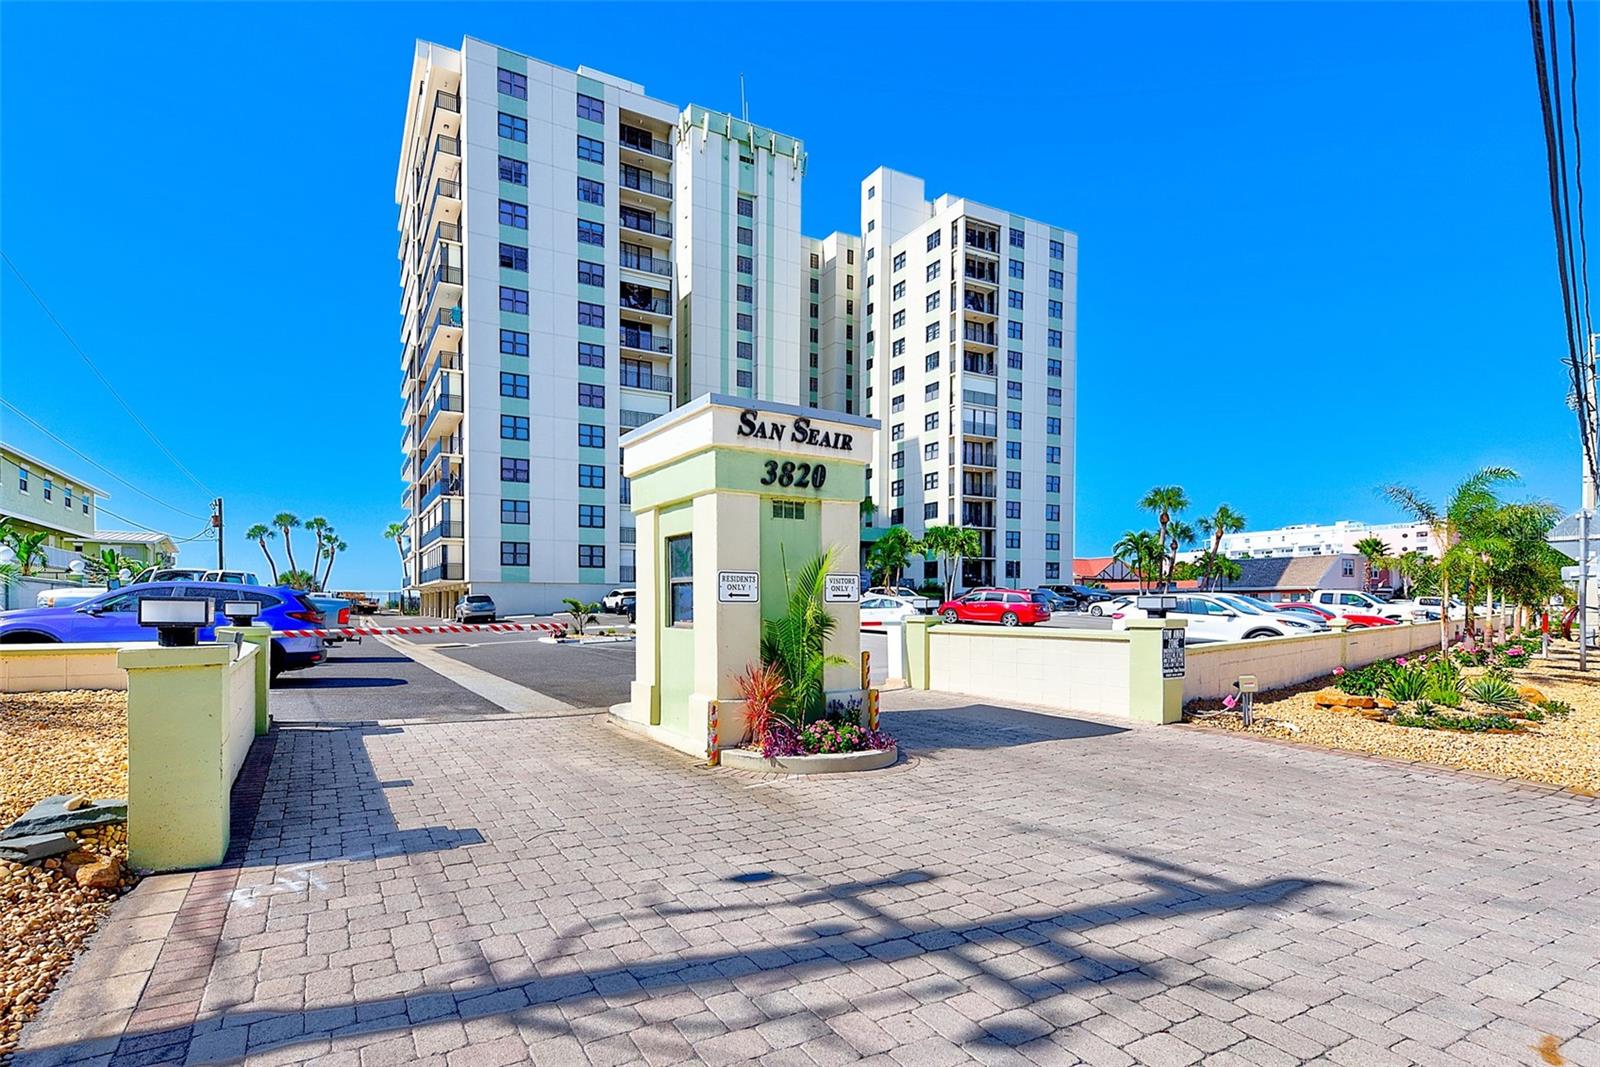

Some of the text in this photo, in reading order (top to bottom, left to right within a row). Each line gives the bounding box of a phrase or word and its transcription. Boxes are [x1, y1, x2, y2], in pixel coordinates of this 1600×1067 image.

[791, 417, 853, 450] SEAIR
[760, 460, 827, 489] 3820
[722, 575, 756, 583] RESIDENTS
[727, 583, 746, 591] ONLY
